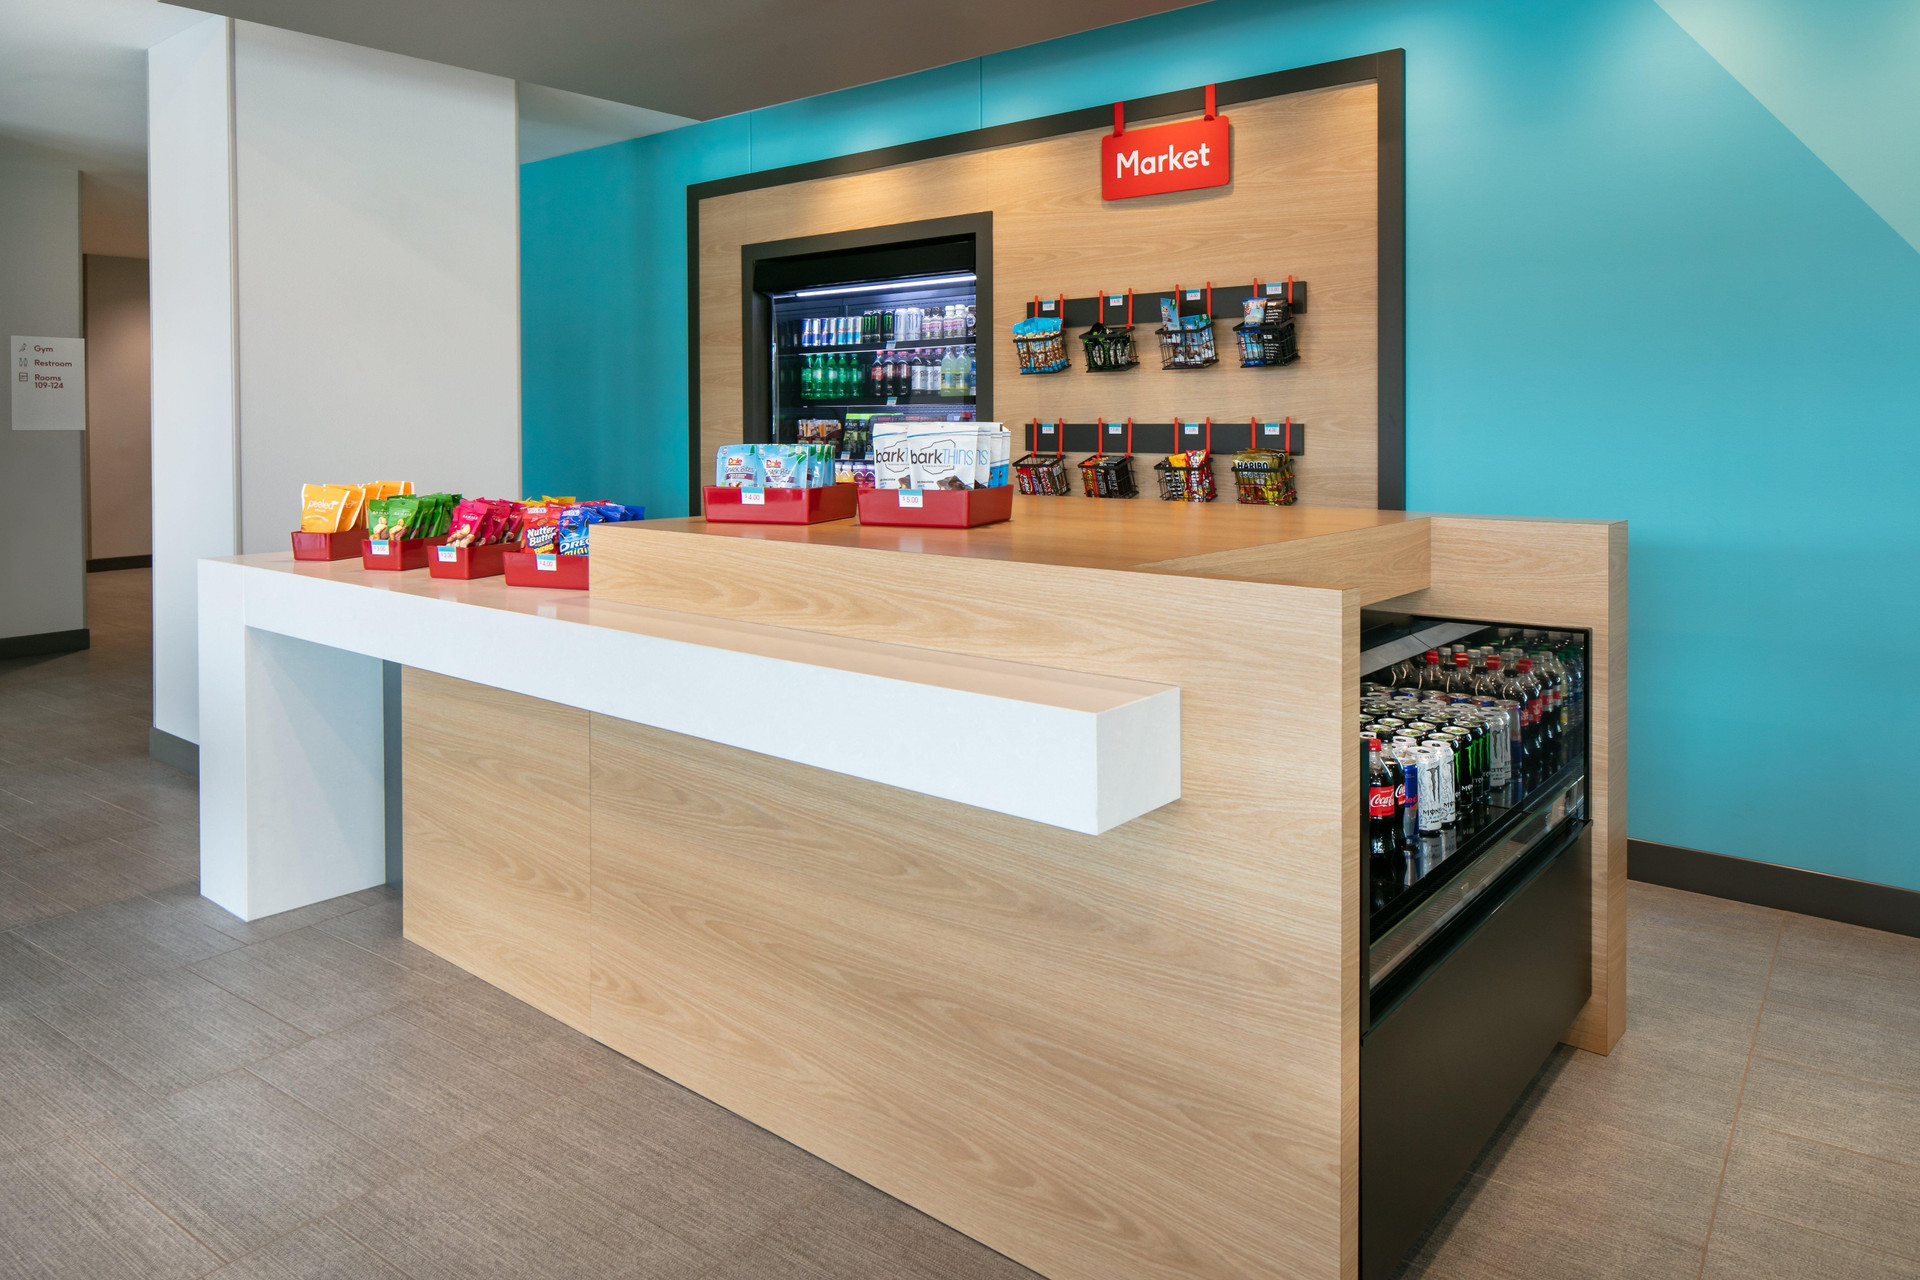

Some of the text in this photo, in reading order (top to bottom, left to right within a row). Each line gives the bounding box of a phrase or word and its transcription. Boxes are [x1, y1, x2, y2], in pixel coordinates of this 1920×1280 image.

[1116, 142, 1210, 179] Market
[34, 345, 54, 354] Gym
[34, 359, 73, 367] Restroom
[34, 373, 62, 381] Rooms
[34, 381, 64, 389] 109-124
[728, 457, 743, 466] Dole
[766, 459, 781, 468] Dole
[1237, 461, 1269, 470] HARIBO
[744, 493, 760, 501] $4.00
[902, 496, 919, 504] $5.00
[527, 526, 557, 539] Nutter
[529, 532, 557, 547] Butter
